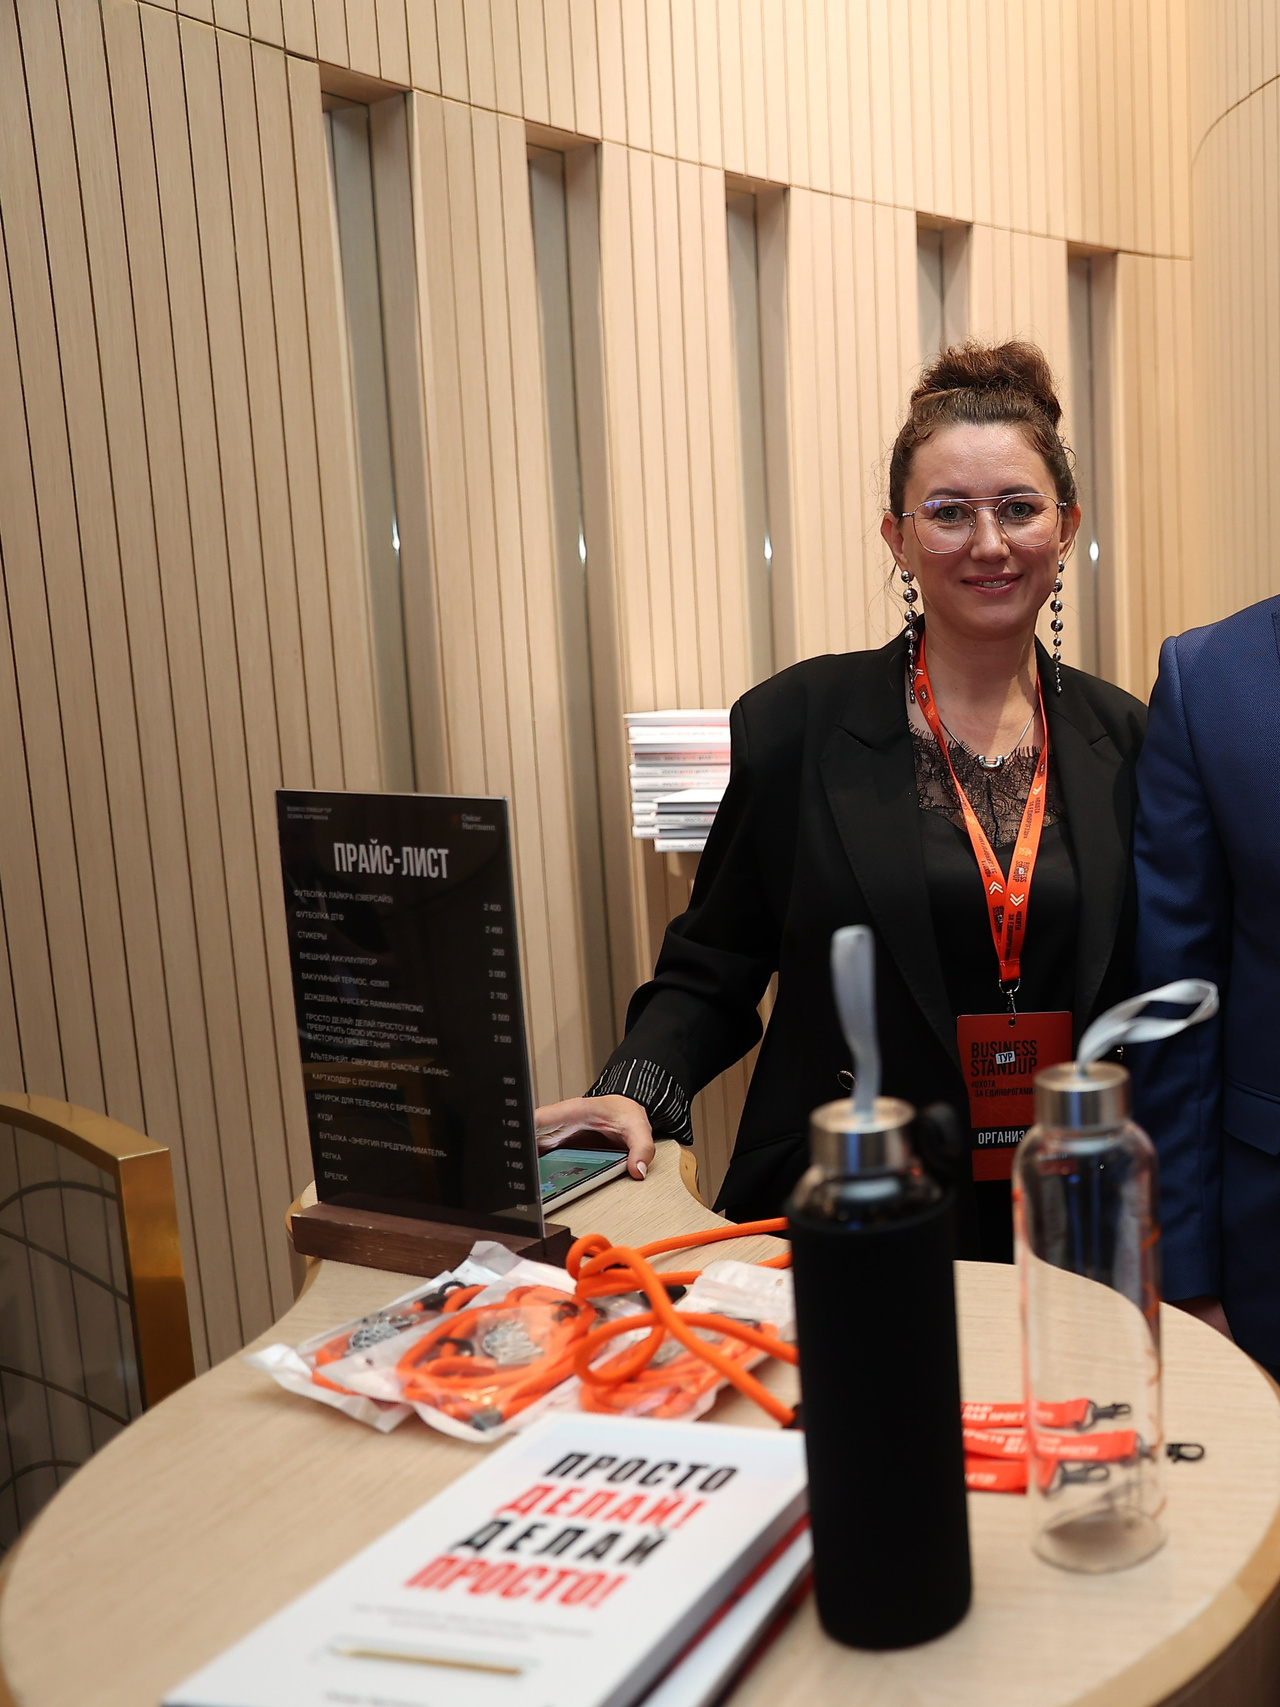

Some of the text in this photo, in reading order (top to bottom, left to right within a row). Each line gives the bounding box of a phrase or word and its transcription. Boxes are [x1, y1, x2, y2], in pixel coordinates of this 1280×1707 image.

[333, 838, 449, 878] ПРАЙС-ЛИСТ
[294, 889, 327, 898] ФУТБОЛКА
[296, 910, 329, 920] ФУТБОЛКА
[297, 931, 328, 941] СТИКЕРЫ
[299, 951, 378, 966] ВНЕШНИЙ АККУМУЛЯТОР
[301, 972, 340, 983] ВАКУУМНЫЙ
[304, 993, 338, 1003] ДОЖДЕВИК
[339, 996, 369, 1007] УНИСЕКС
[305, 1013, 331, 1023] ПРОСТО
[355, 1018, 376, 1028] ДЕЛАЙ
[405, 1024, 419, 1034] КАК
[306, 1023, 438, 1045] ПРЕВРАТИТЬ СВОЮ ИСТОРИЮ СТРАДАНИЯ
[313, 1033, 344, 1044] ИСТОРИЮ
[344, 1036, 391, 1049] ПРОЦВЕТАНИЯ
[971, 1040, 1037, 1058] BUSINESS
[998, 1052, 1013, 1063] ТУР
[423, 1066, 449, 1077] БАЛАНС
[971, 1057, 1038, 1077] STANDUP
[312, 1073, 351, 1084] КАРТХОЛДЕР
[358, 1079, 397, 1090] ЛОГОТИПОМ
[985, 1087, 1034, 1097] ЕДИНОРОГАМИ
[315, 1092, 340, 1103] ШНУРОК
[341, 1096, 354, 1105] ДЛЯ
[355, 1098, 389, 1110] ТЕЛЕФОНА
[396, 1104, 431, 1116] БРЕЛОКОМ
[317, 1112, 333, 1121] ХУДИ
[319, 1131, 347, 1142] БУТЫЛКА
[978, 1130, 1025, 1145] ОРГАНИЗ
[321, 1152, 342, 1162] КЕПКА
[324, 1171, 348, 1182] БРЕЛОК
[544, 1452, 739, 1493] ПРОСТО
[492, 1483, 707, 1531] ДЕЛАЙ!
[449, 1518, 671, 1567] ДЕЛАЙ
[401, 1554, 629, 1609] ПРОСТО!
